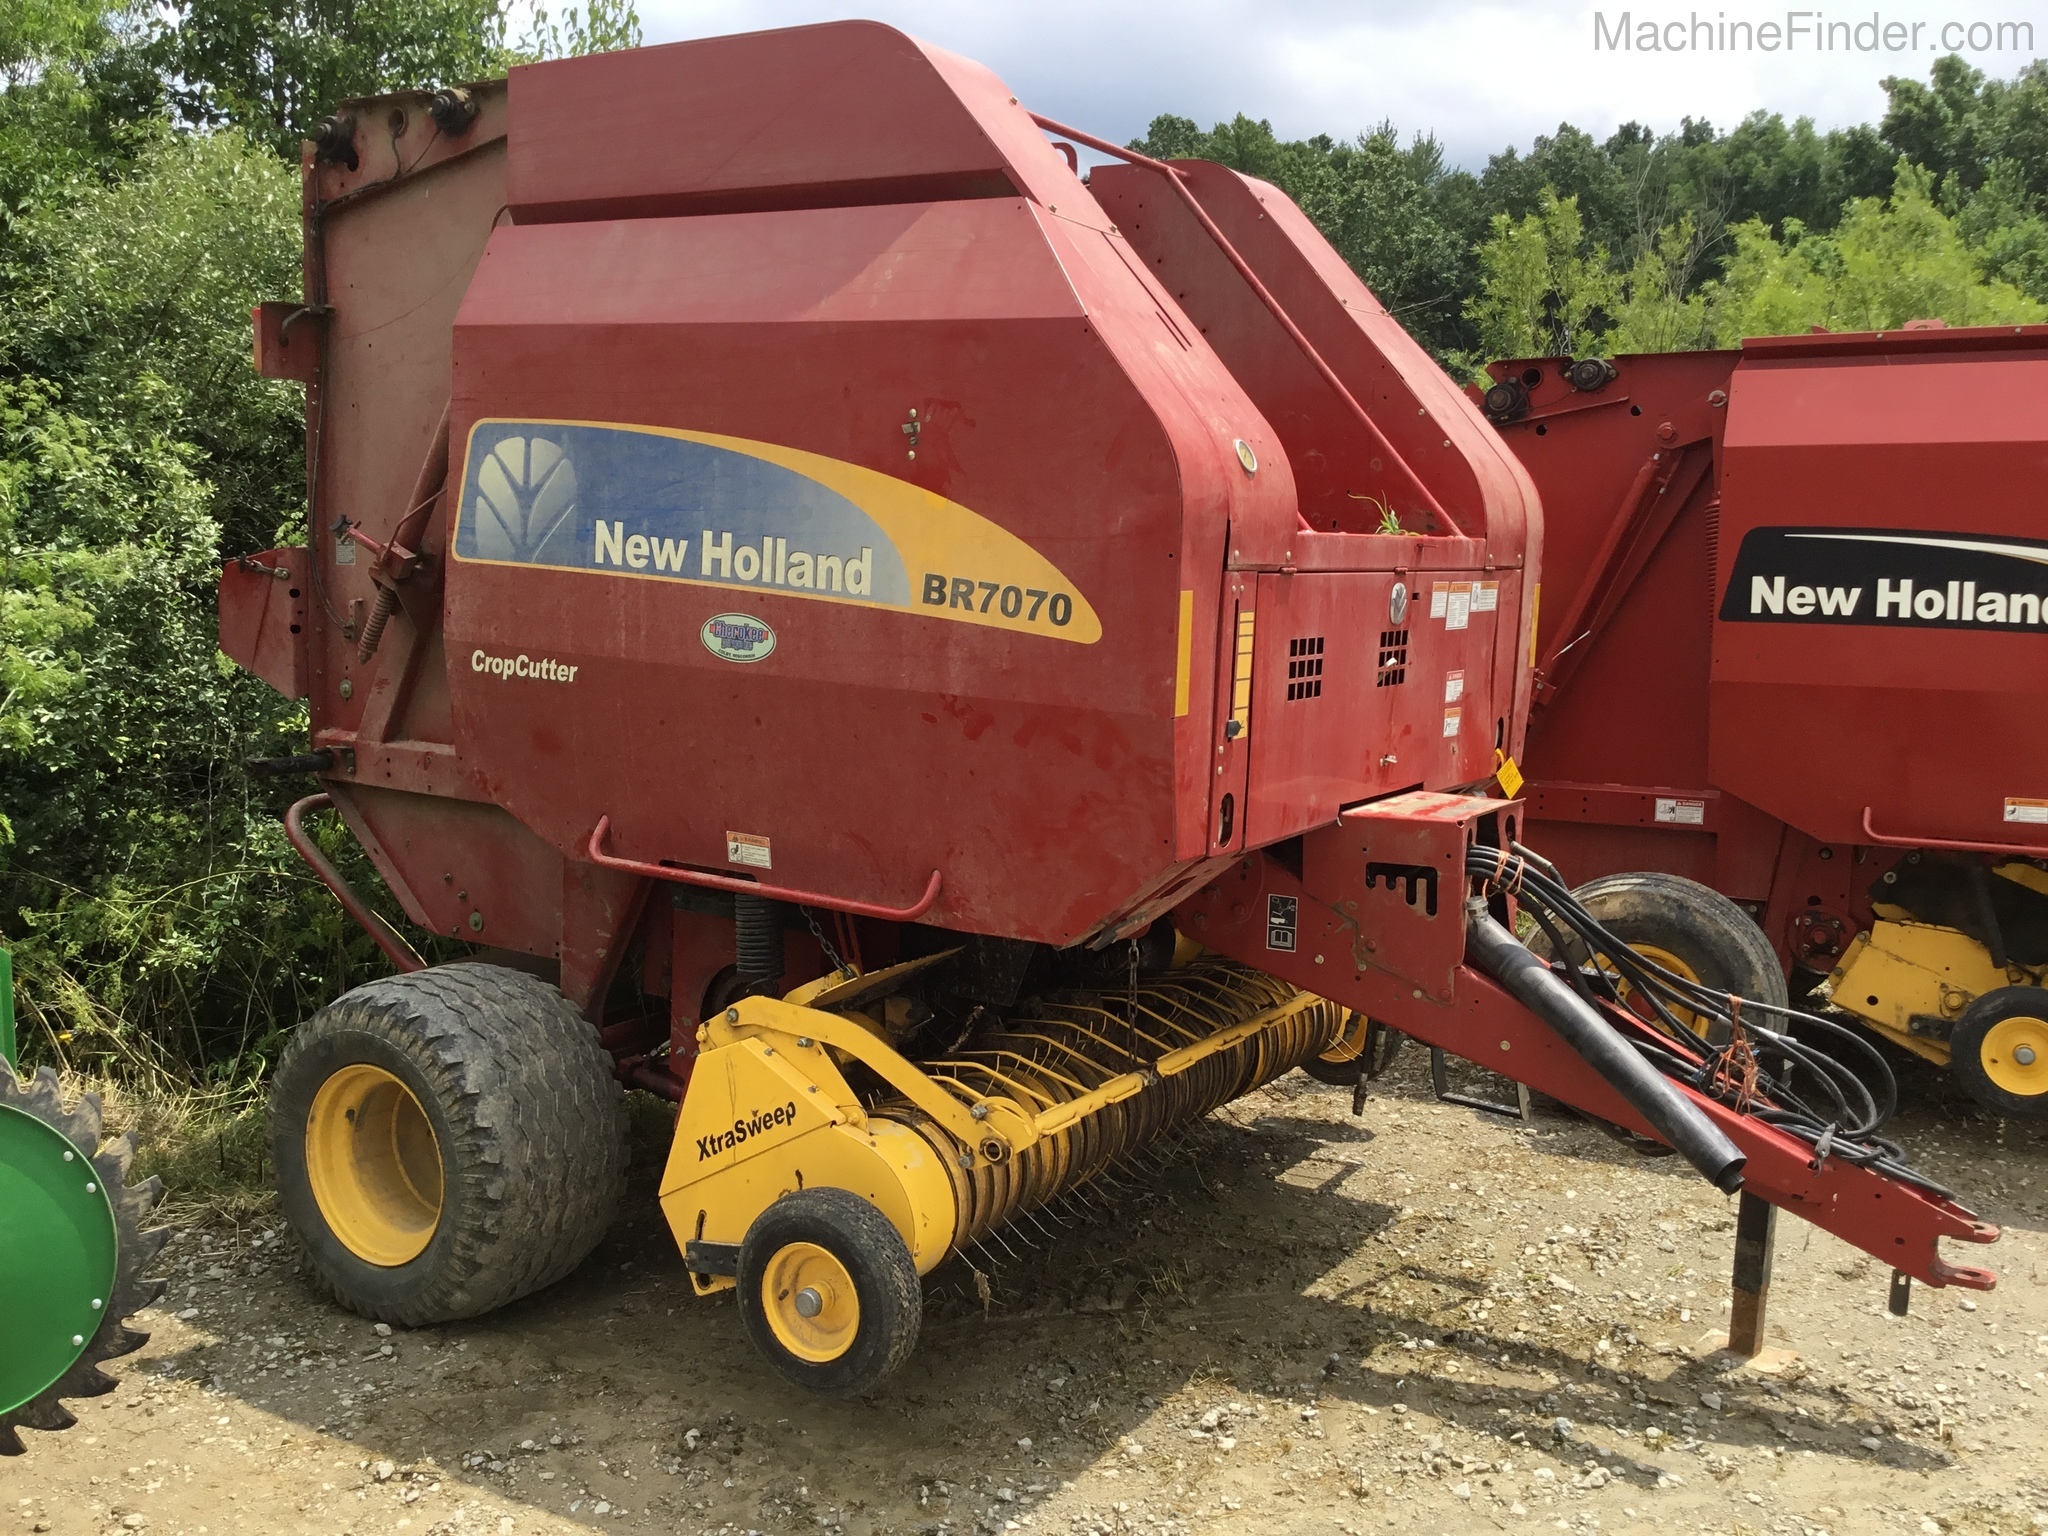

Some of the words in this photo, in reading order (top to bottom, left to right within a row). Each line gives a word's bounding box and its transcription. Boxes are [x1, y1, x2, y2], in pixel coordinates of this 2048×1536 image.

[594, 518, 689, 573] New
[701, 529, 873, 596] Holland
[922, 572, 1072, 626] BR7070
[1750, 575, 1862, 616] New
[1875, 578, 2048, 624] Hollan
[713, 620, 764, 643] Cherokee
[471, 649, 579, 682] CropCutter
[696, 1101, 796, 1162] XtraSweep
